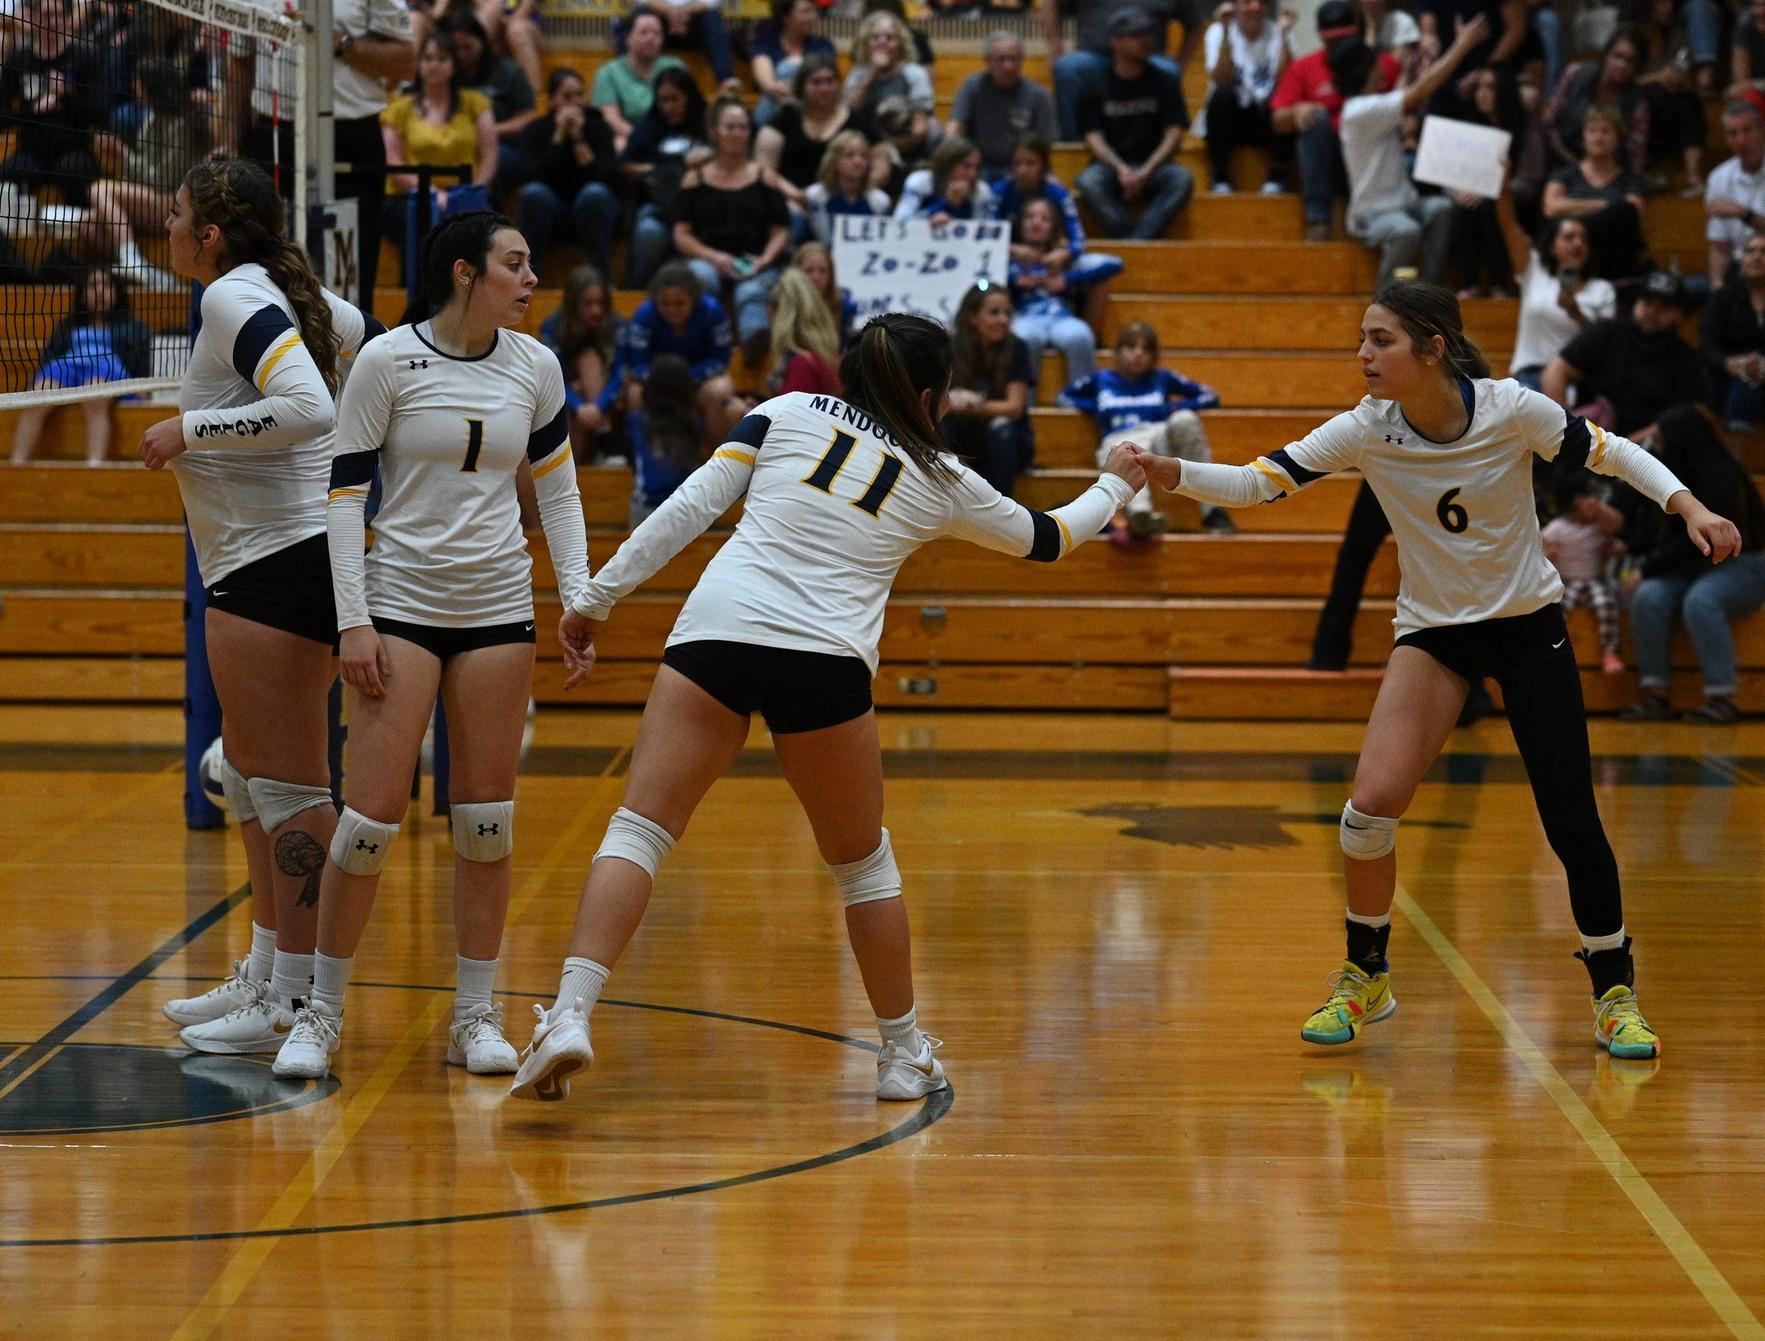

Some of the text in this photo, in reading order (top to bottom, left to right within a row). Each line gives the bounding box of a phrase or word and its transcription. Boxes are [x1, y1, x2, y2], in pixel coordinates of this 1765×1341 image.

[195, 415, 278, 438] EAGLES
[460, 416, 484, 474] 1
[800, 424, 906, 520] 11
[1436, 486, 1469, 534] 6
